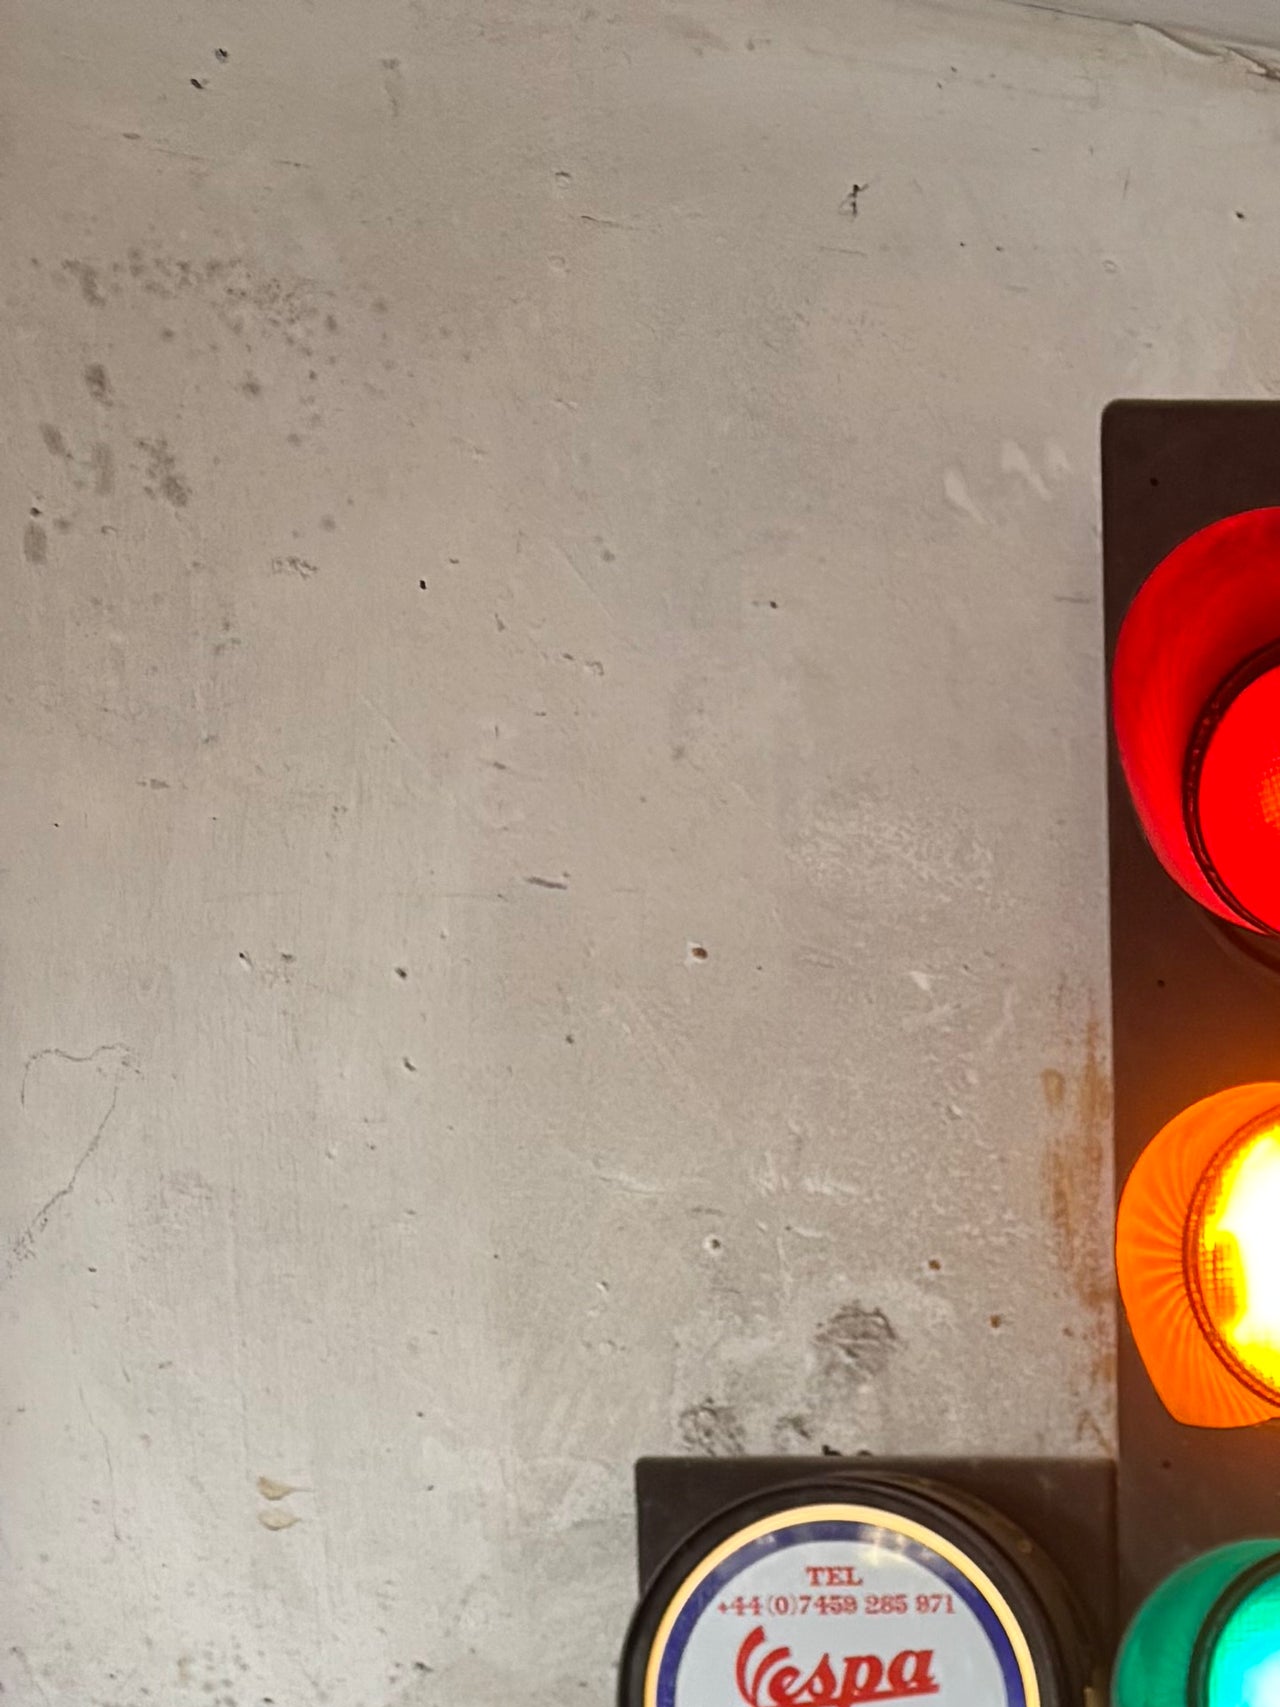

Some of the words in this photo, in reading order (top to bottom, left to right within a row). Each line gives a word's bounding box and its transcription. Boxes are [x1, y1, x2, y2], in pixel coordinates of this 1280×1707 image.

[805, 1565, 864, 1588] TEL
[864, 1594, 908, 1615] 285
[915, 1593, 956, 1615] 971
